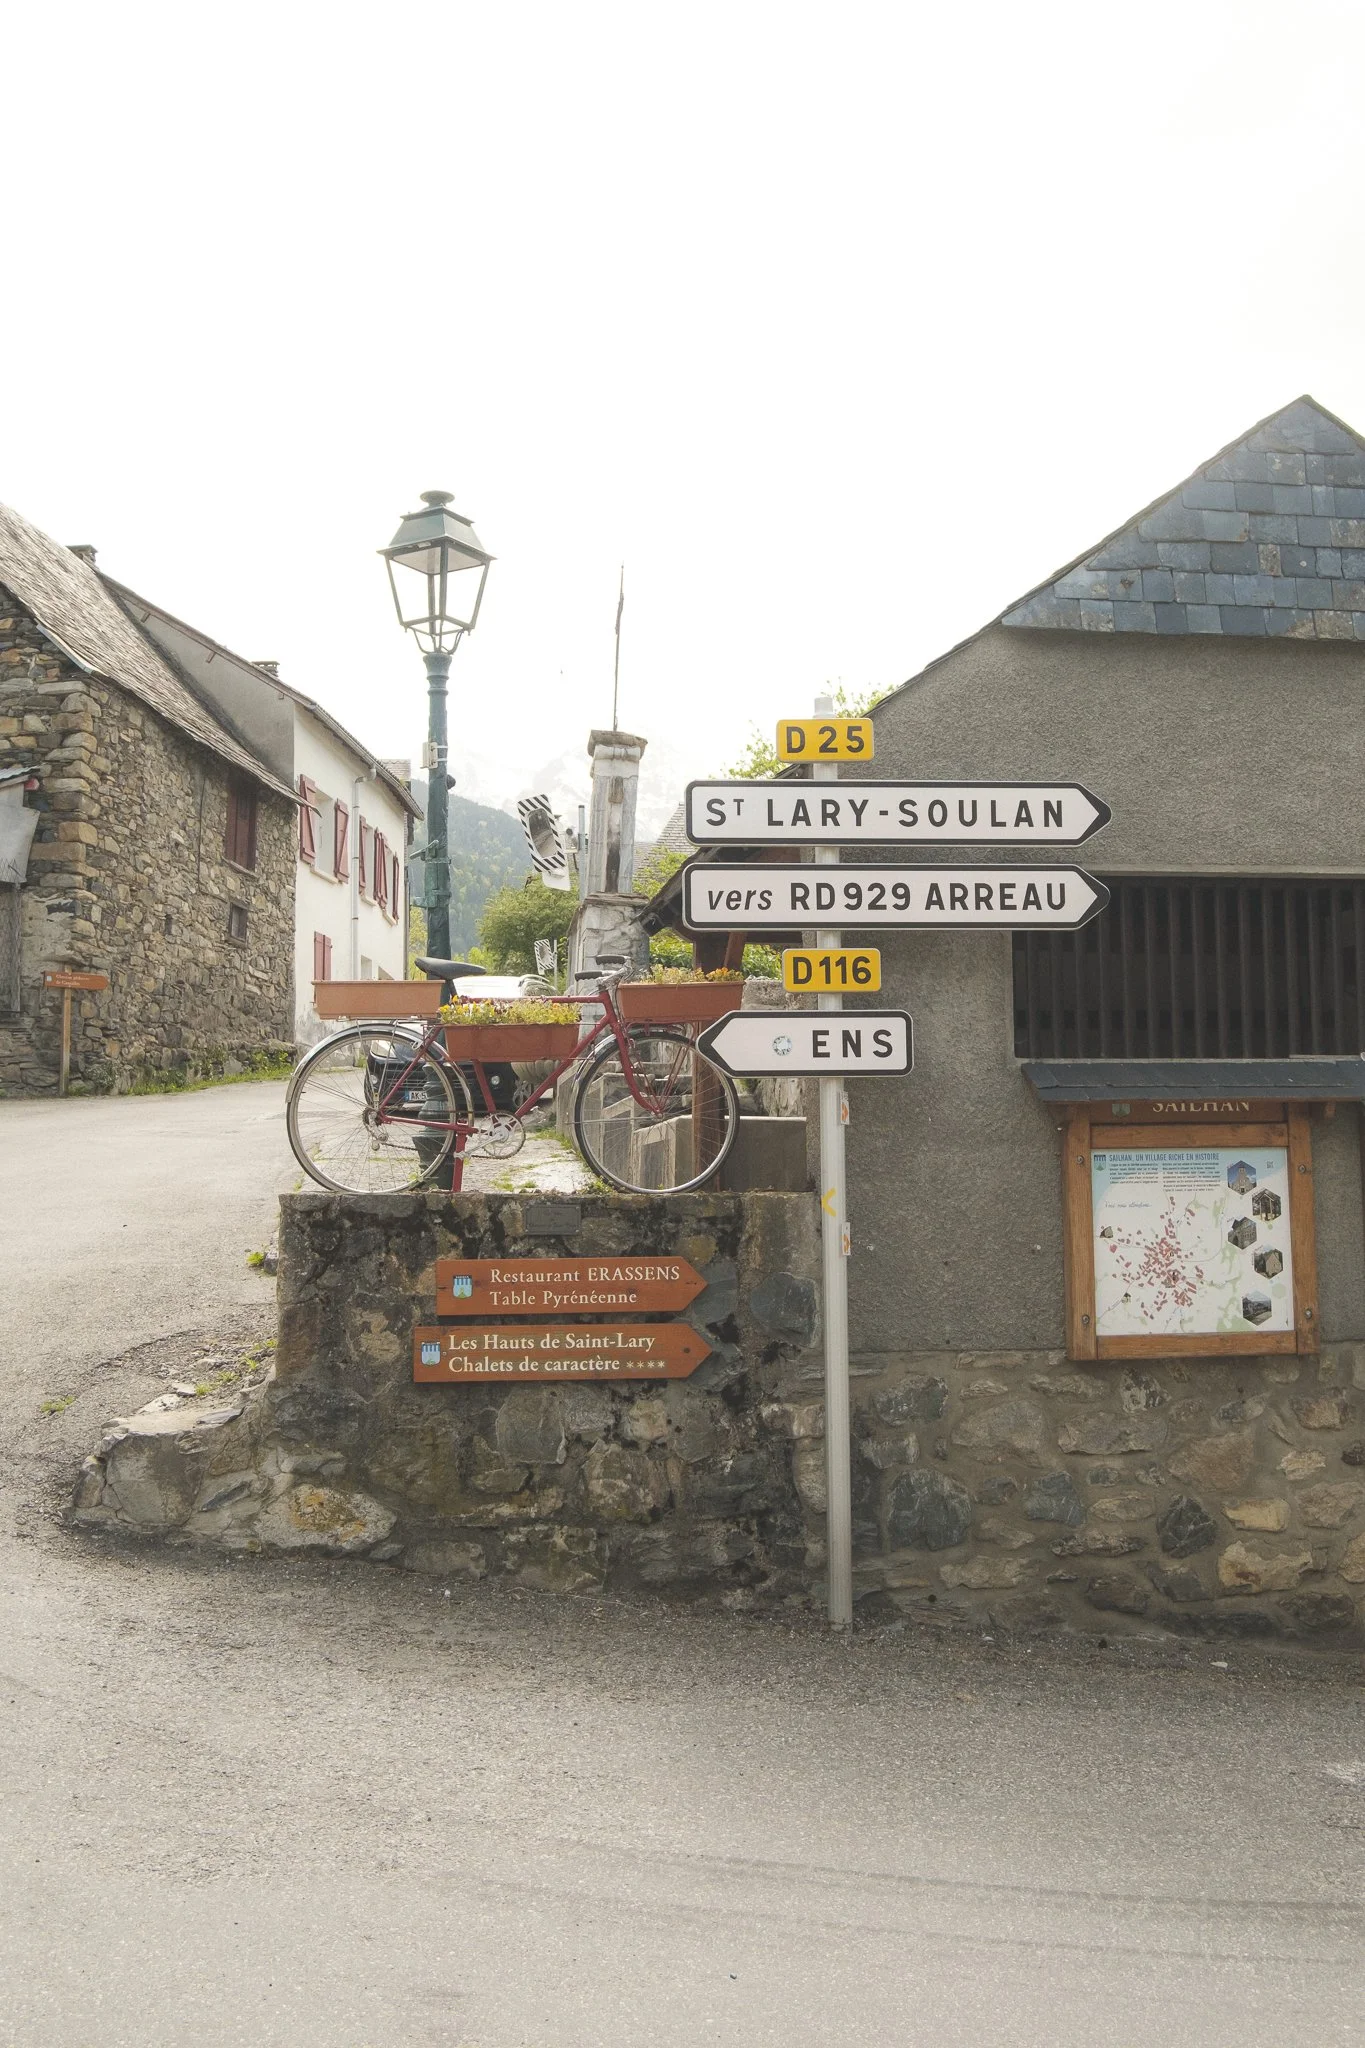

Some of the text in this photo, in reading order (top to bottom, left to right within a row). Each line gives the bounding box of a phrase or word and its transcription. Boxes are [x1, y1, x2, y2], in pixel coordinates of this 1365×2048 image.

[786, 726, 865, 753] D 25
[766, 798, 1064, 828] LARY-SOULAN
[707, 882, 1067, 911] vers RD929 ARREAU
[811, 1029, 894, 1059] ENS
[491, 1266, 681, 1283] Restaurant ERASSENS
[489, 1290, 637, 1308] Table Pyrénéenne
[449, 1332, 656, 1352] Les Hauts de Saint-Lary
[448, 1355, 620, 1373] Chalets de caractère
